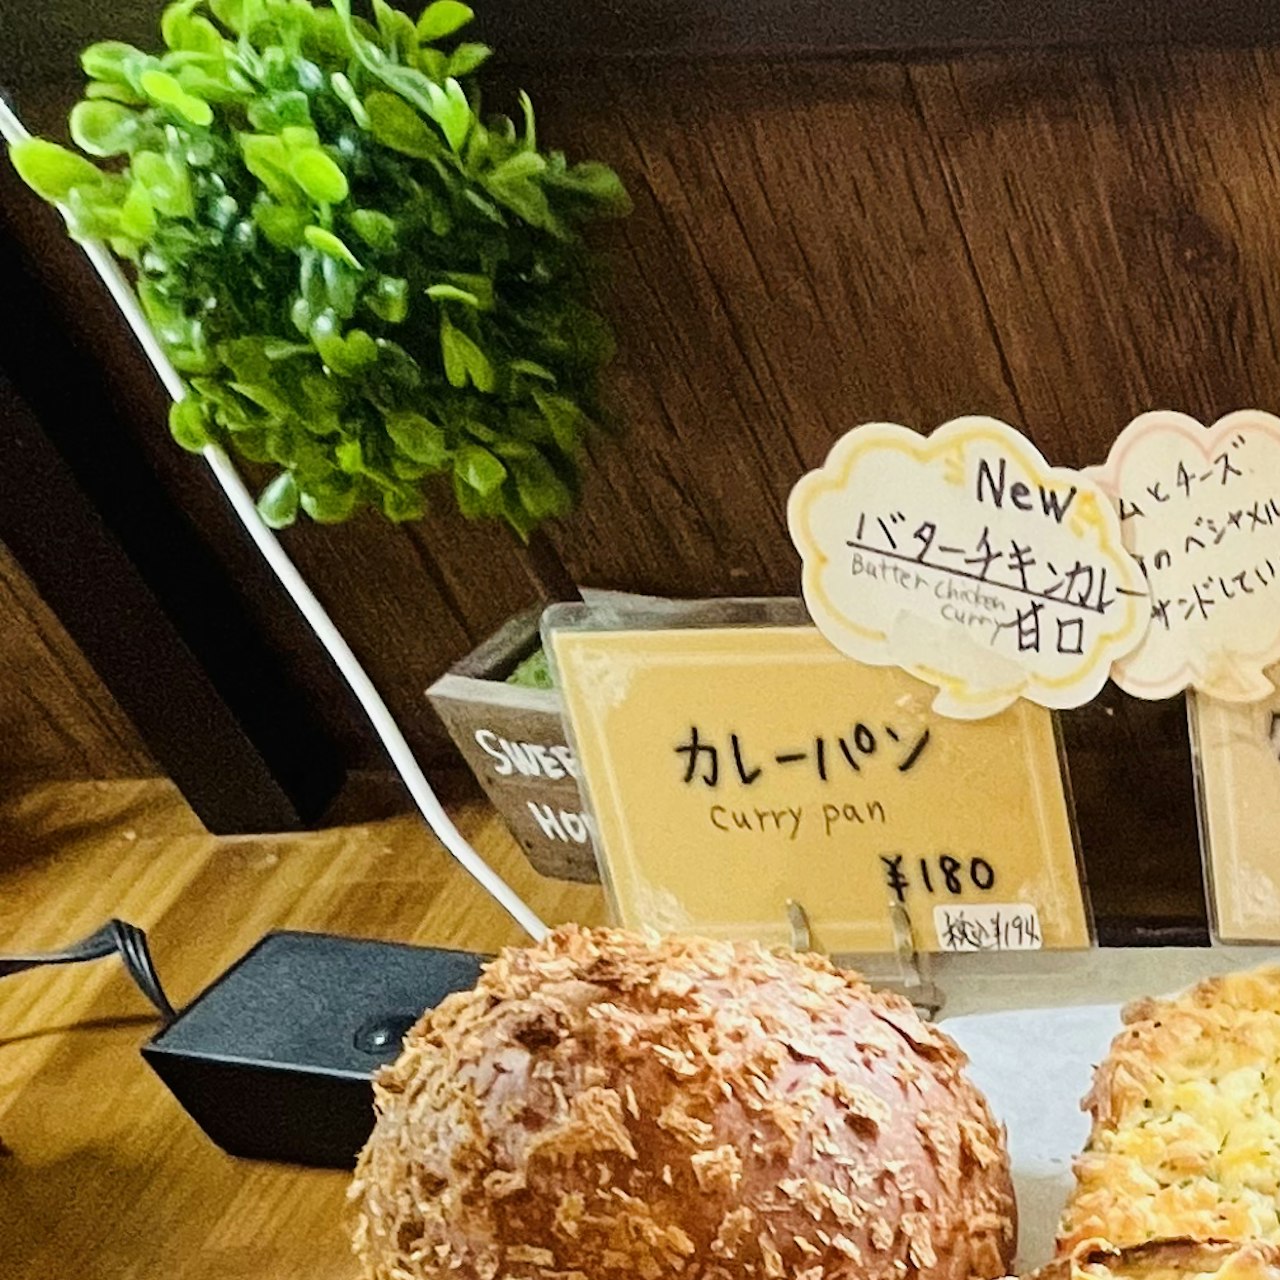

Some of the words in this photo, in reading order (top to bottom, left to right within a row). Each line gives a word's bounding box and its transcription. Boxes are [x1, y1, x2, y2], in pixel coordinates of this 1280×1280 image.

[976, 458, 1078, 524] New
[1119, 435, 1246, 521] ムとチーズ
[851, 552, 929, 590] Butter
[856, 512, 1149, 614] バターチキンカレー
[1016, 600, 1083, 654] 甘口
[673, 721, 932, 788] カレーパン
[821, 798, 887, 837] pan
[879, 853, 996, 902] ¥180
